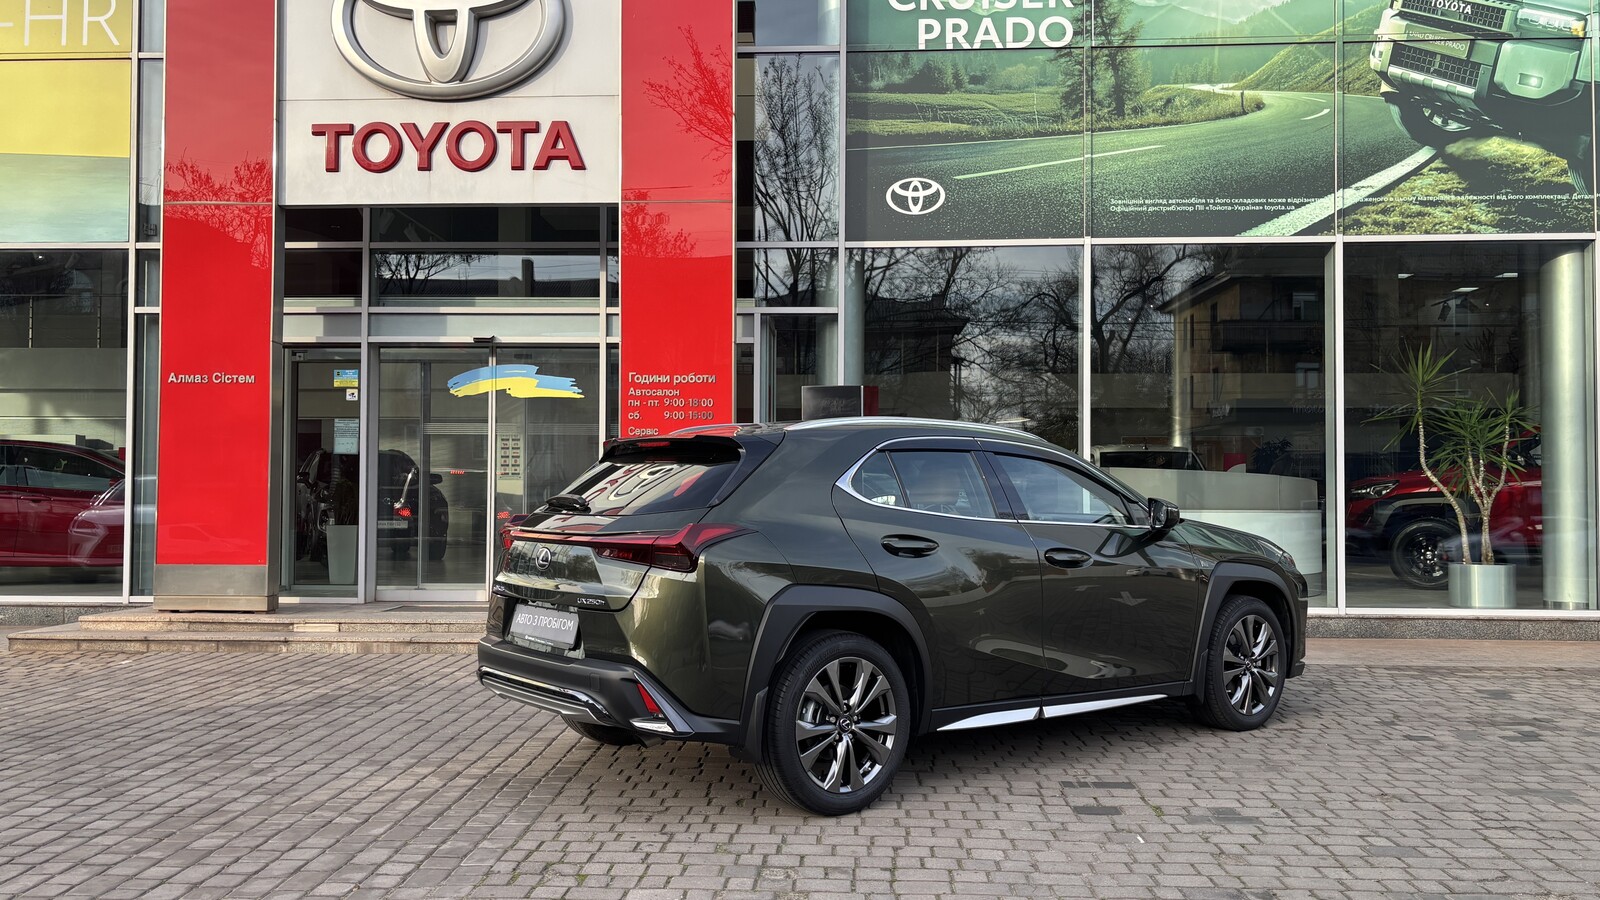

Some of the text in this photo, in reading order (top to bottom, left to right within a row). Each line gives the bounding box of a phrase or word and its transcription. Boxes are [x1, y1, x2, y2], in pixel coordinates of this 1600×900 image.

[917, 16, 1074, 50] PRADO
[311, 120, 587, 173] TOYOTA
[1496, 193, 1507, 201] від
[1264, 204, 1296, 212] toyota.ua
[167, 372, 255, 383] Алмаз Сістем
[628, 372, 716, 386] Години роботи
[628, 387, 680, 397] Автосалон
[628, 399, 640, 407] пн
[628, 410, 642, 420] сб.
[628, 426, 659, 437] Сервіс
[515, 613, 574, 631] АВТО З ПРОБІГОМ
